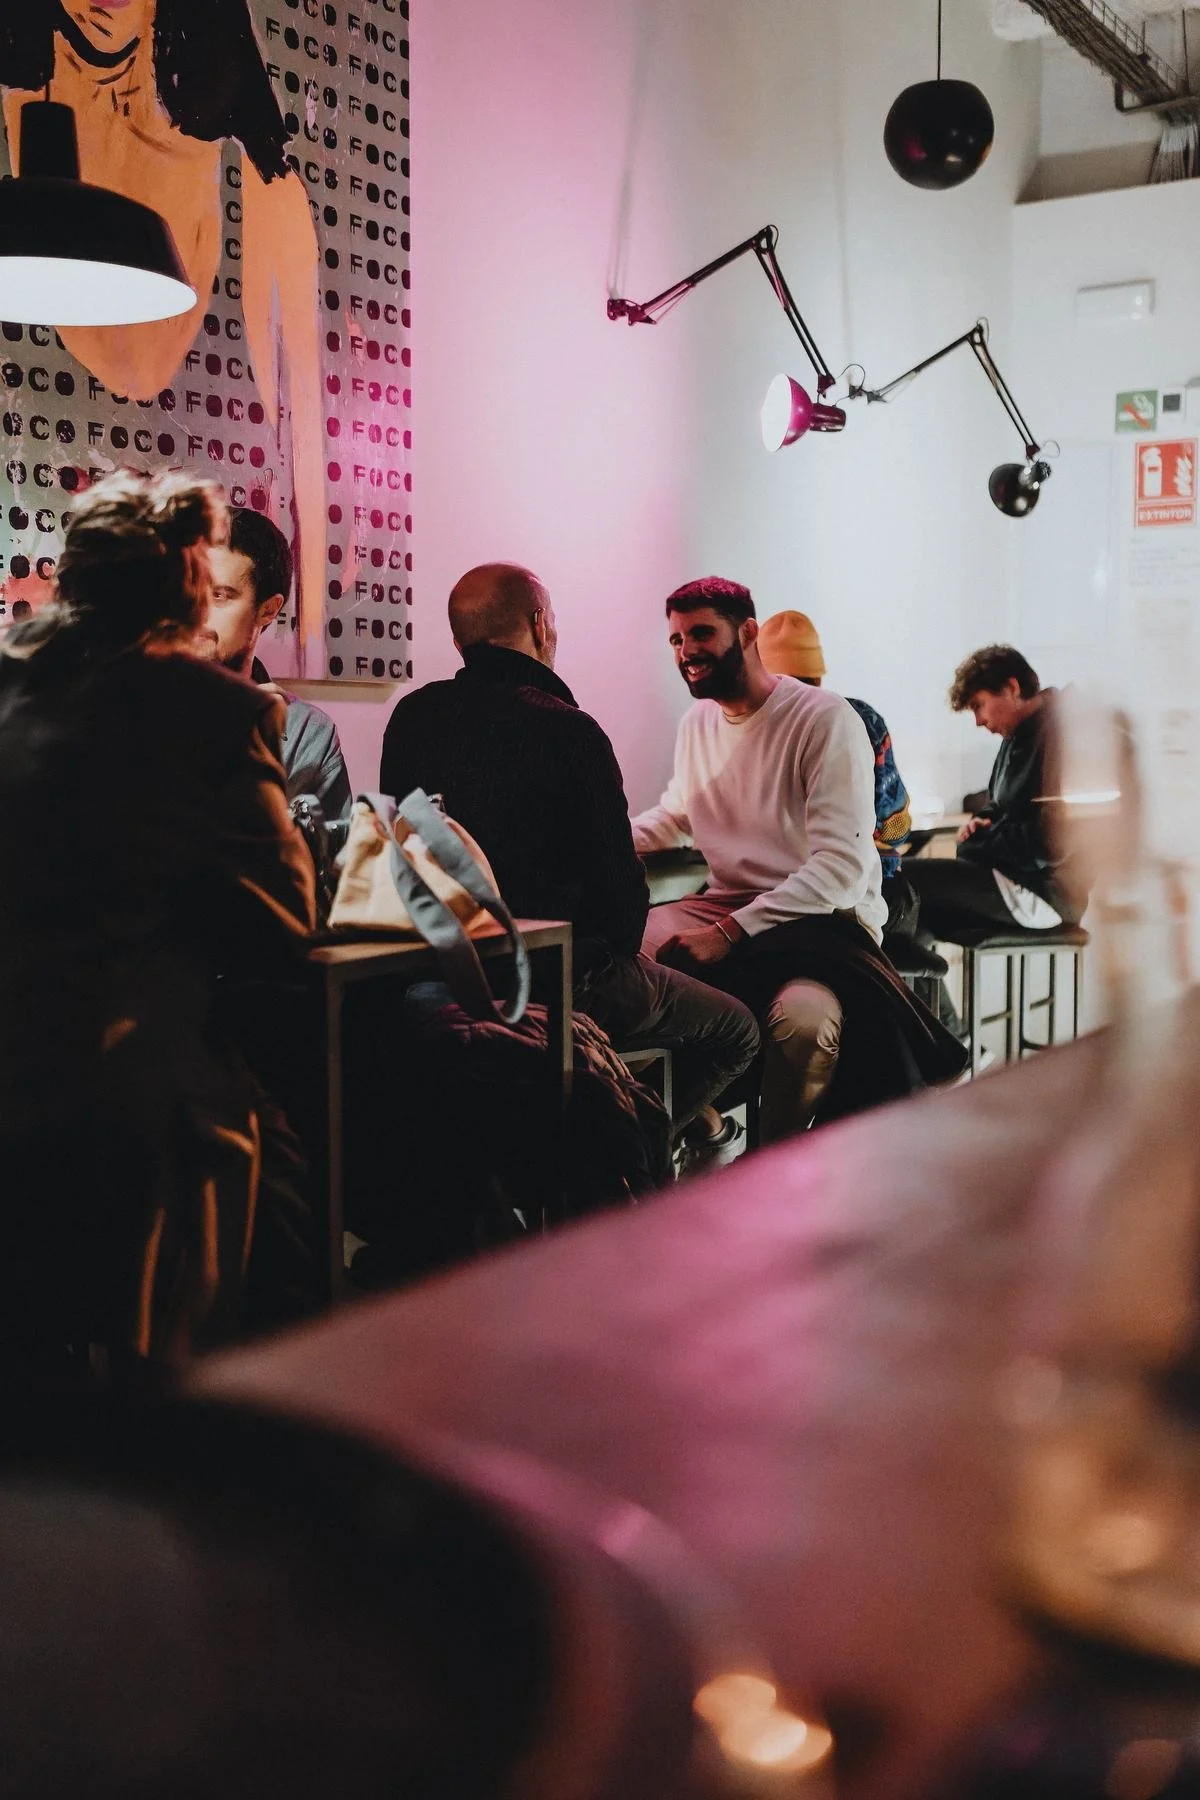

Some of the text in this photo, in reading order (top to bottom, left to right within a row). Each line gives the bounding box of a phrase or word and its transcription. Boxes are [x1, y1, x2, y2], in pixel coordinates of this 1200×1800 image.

[266, 17, 337, 66] FOCO
[285, 112, 337, 149] OCO
[1, 362, 75, 396] OCO
[186, 390, 264, 424] FOCO
[3, 411, 265, 468] OCO FOCO FOCO
[6, 460, 79, 491] OCO
